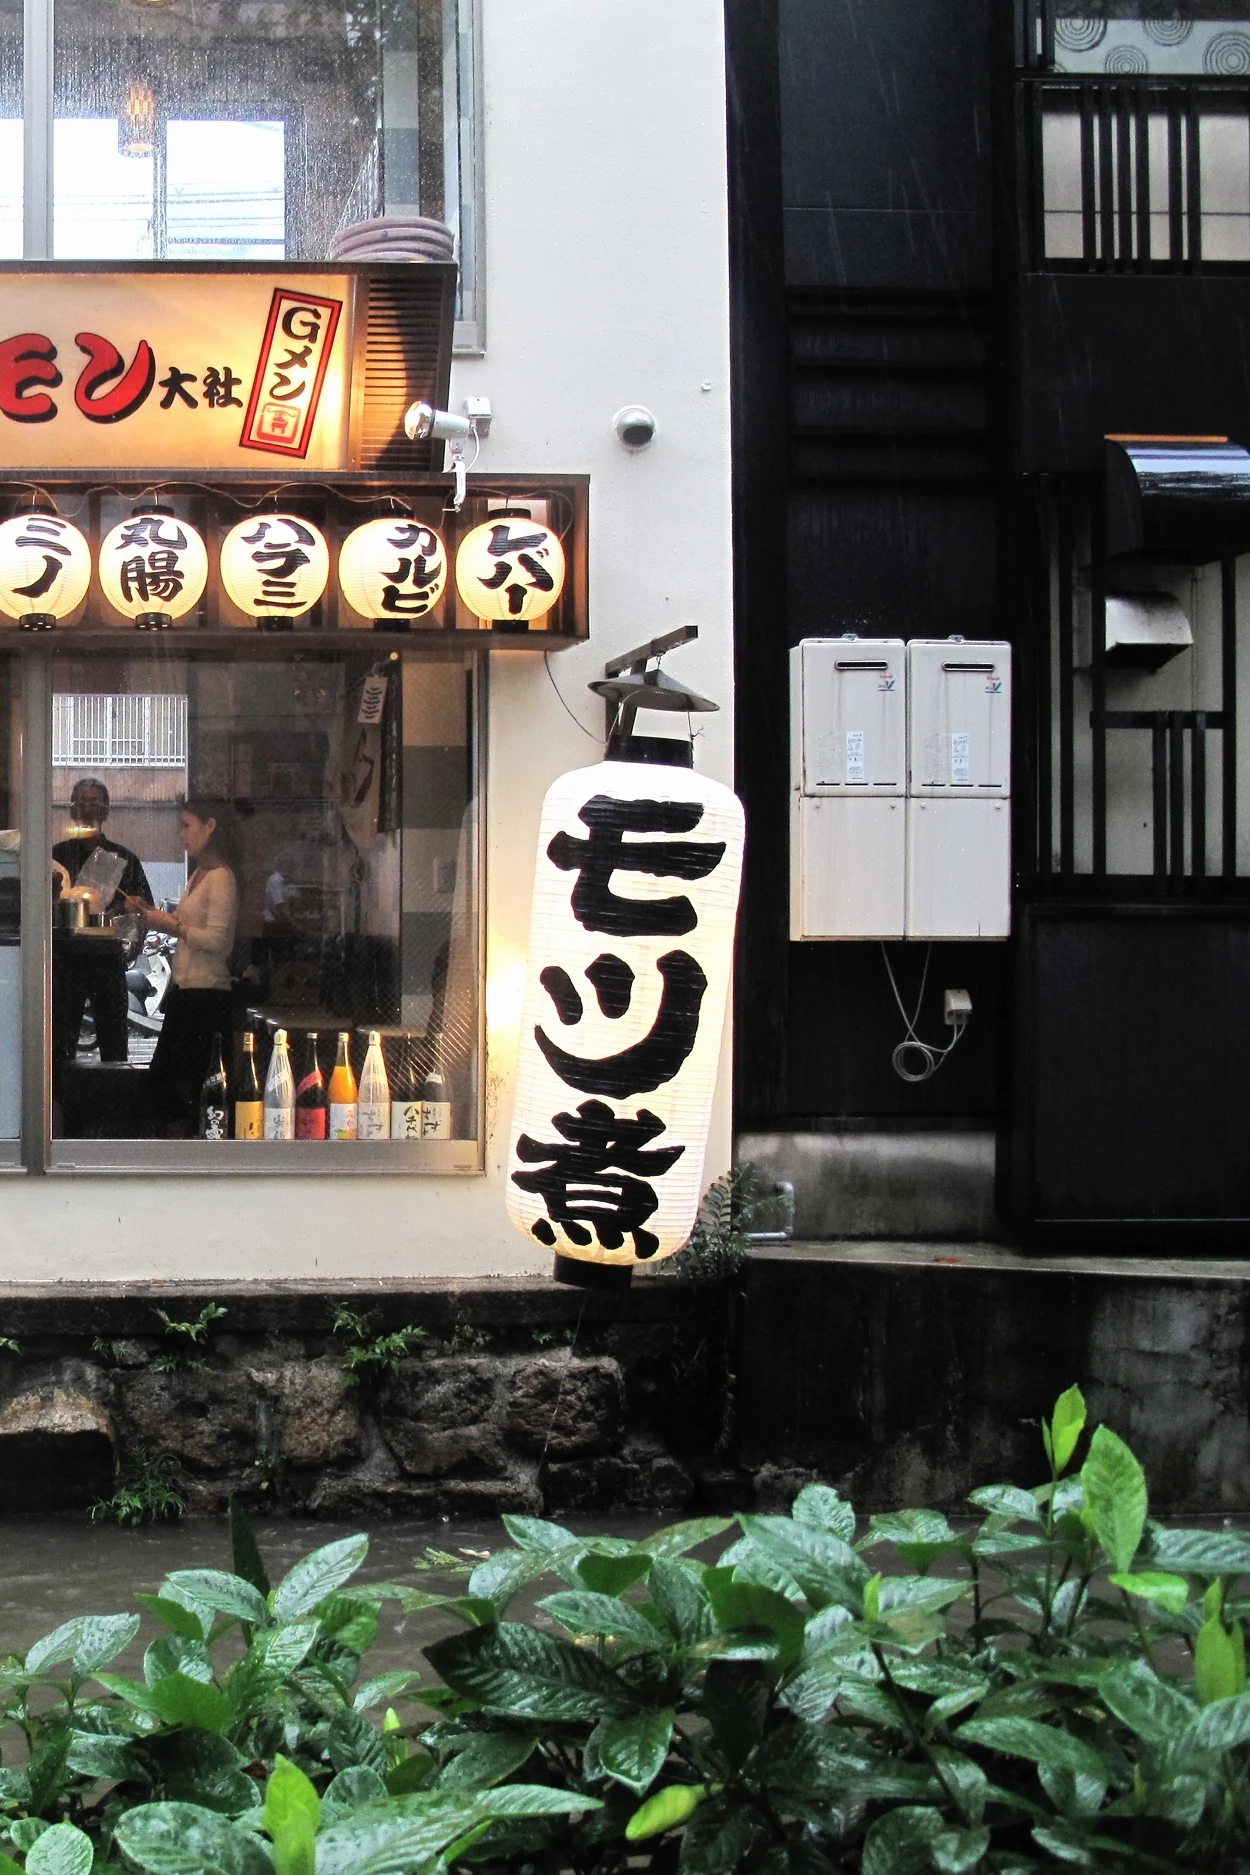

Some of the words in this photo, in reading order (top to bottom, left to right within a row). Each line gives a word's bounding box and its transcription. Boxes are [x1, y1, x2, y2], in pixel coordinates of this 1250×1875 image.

[269, 306, 321, 401] Gメン
[11, 517, 72, 597] ミノ
[116, 517, 187, 602] 丸腸
[241, 519, 315, 609] ハラミ
[382, 524, 442, 613] カルビ
[477, 524, 553, 614] レバー
[511, 794, 727, 1259] モツ煮
